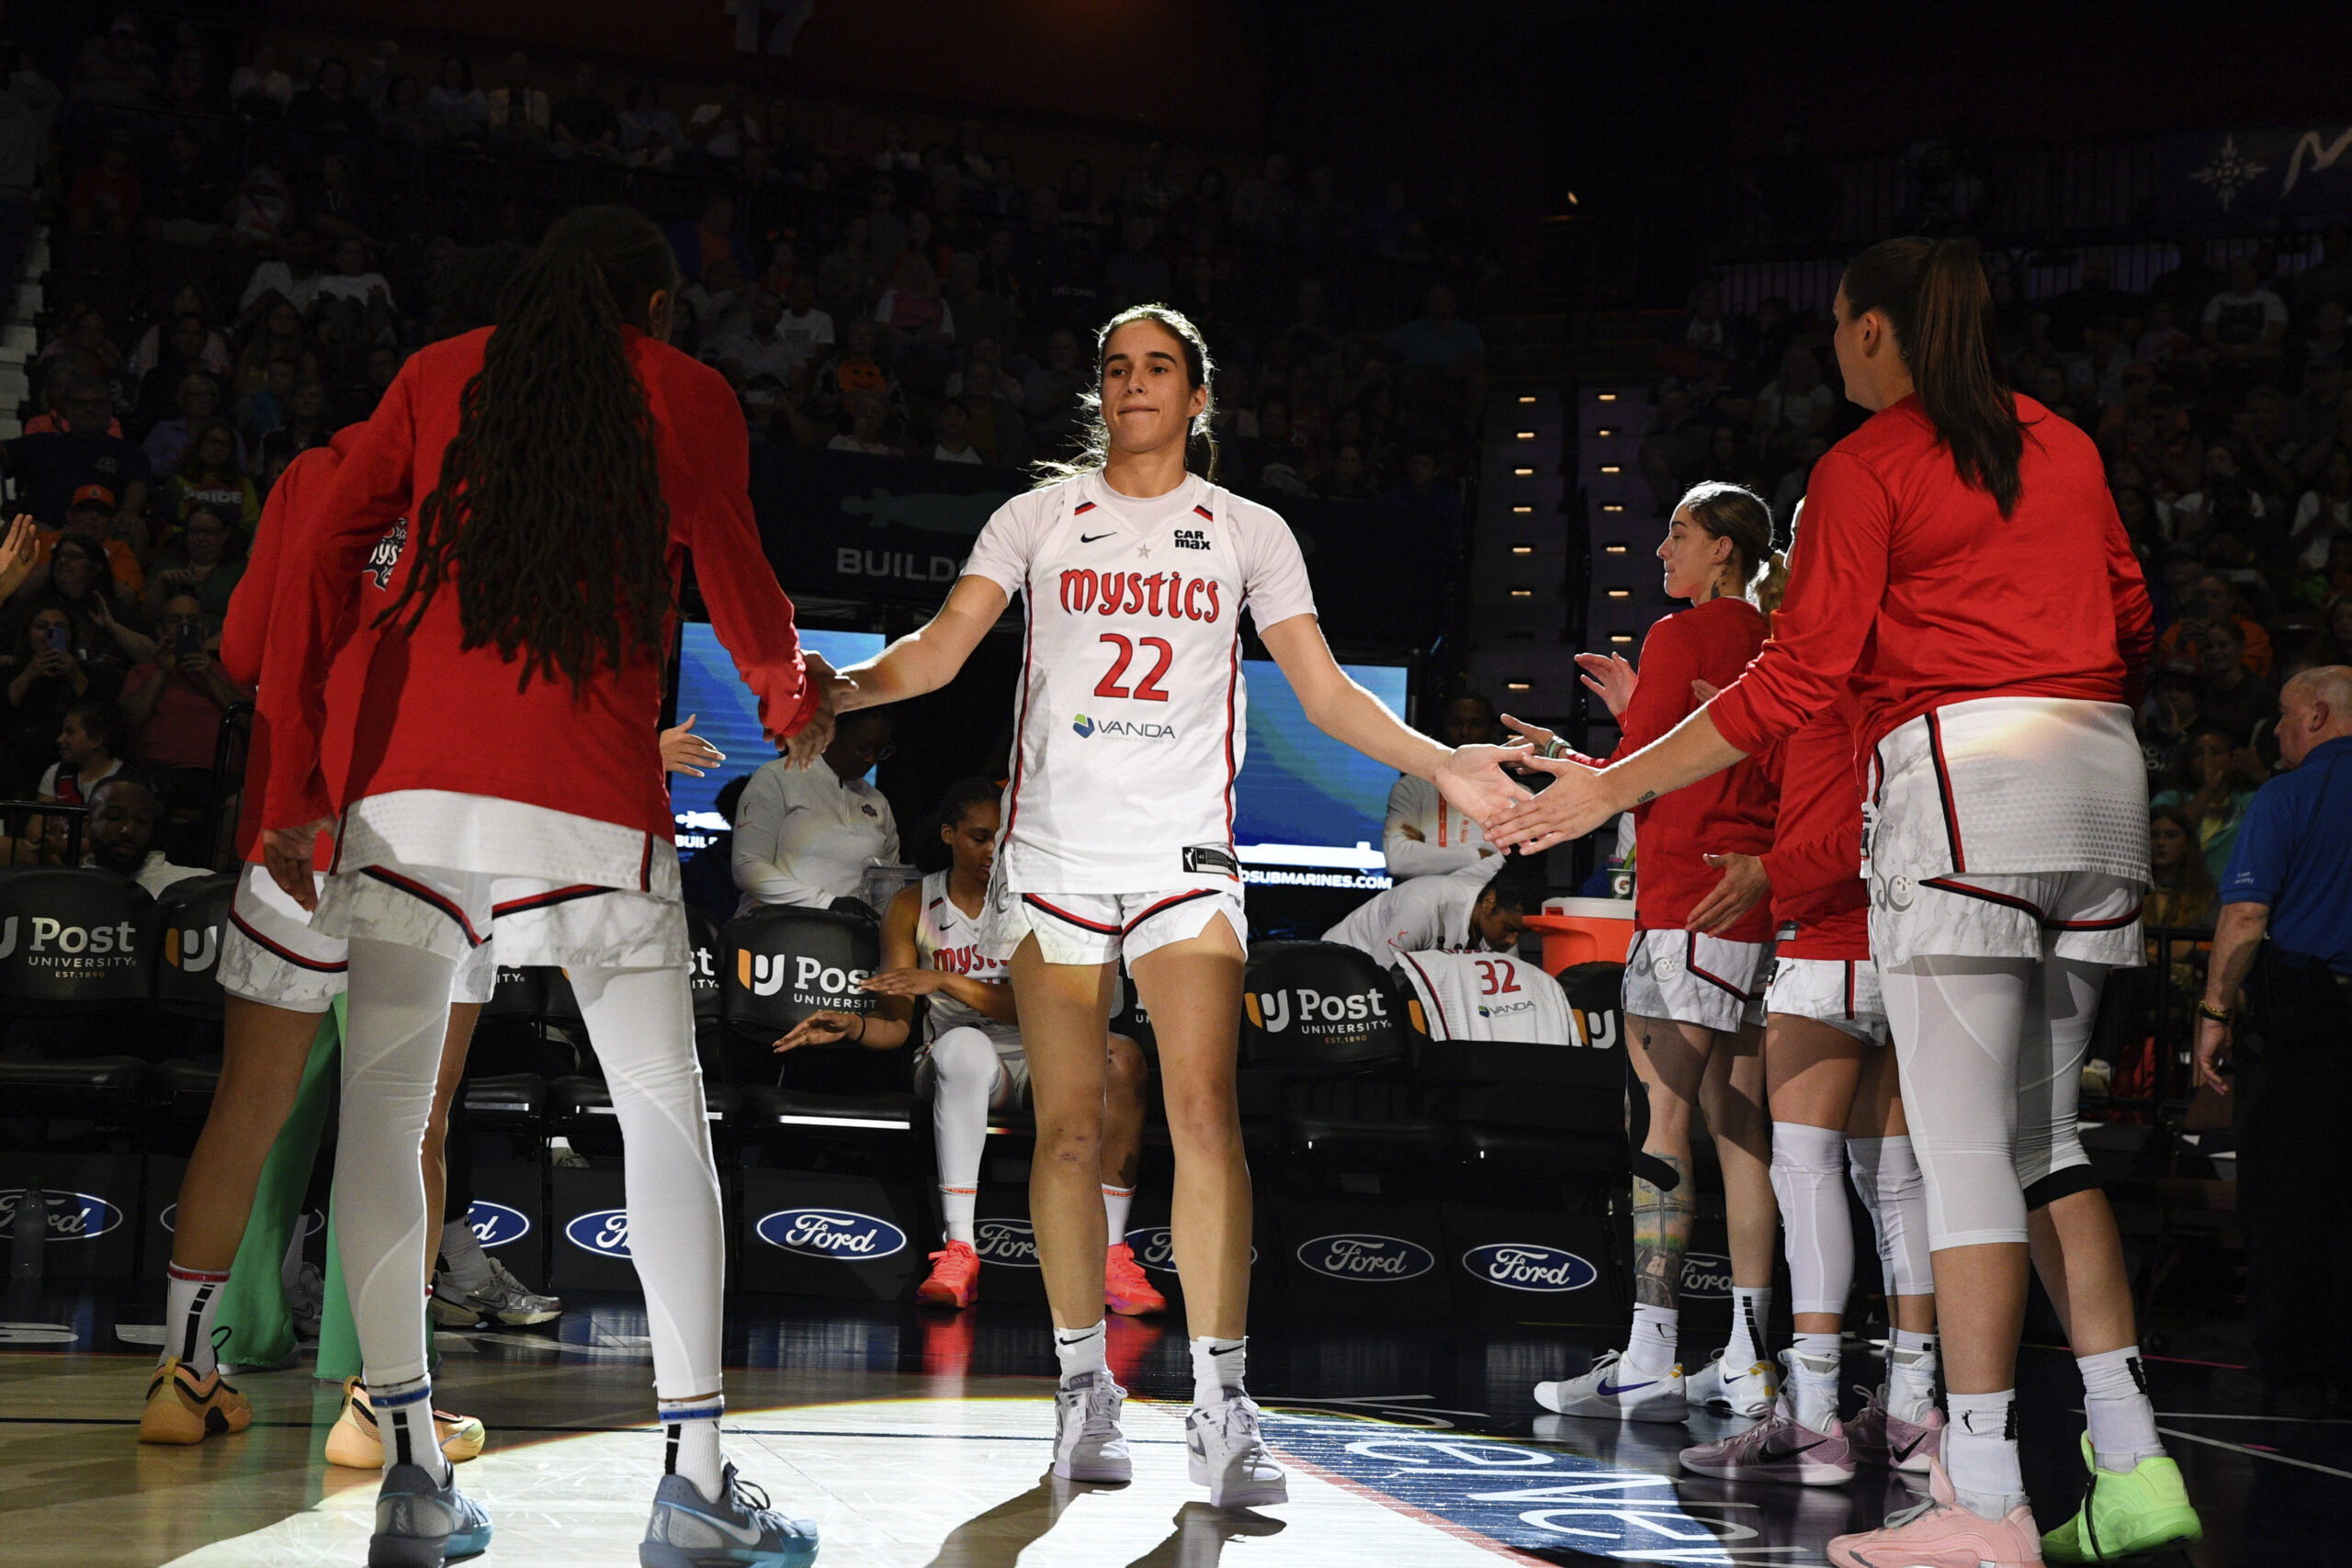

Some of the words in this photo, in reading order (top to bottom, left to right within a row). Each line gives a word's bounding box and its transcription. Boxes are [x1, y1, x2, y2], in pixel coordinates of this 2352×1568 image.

[1173, 529, 1204, 540] CAR
[1174, 538, 1211, 550] max
[836, 547, 967, 582] BUILD
[1059, 568, 1220, 624] mystics
[1093, 633, 1173, 702] 22
[1097, 719, 1176, 739] VANDA
[28, 916, 137, 953] Post
[794, 955, 879, 996] Pos
[1475, 959, 1521, 995] 32
[1296, 987, 1387, 1021] Post
[1489, 1000, 1535, 1016] VANDA
[1324, 1034, 1368, 1044] EST.1890
[786, 1214, 877, 1253] Ford
[976, 1224, 1040, 1258] For
[1325, 1240, 1408, 1275] Ford
[1488, 1248, 1571, 1286] Ford
